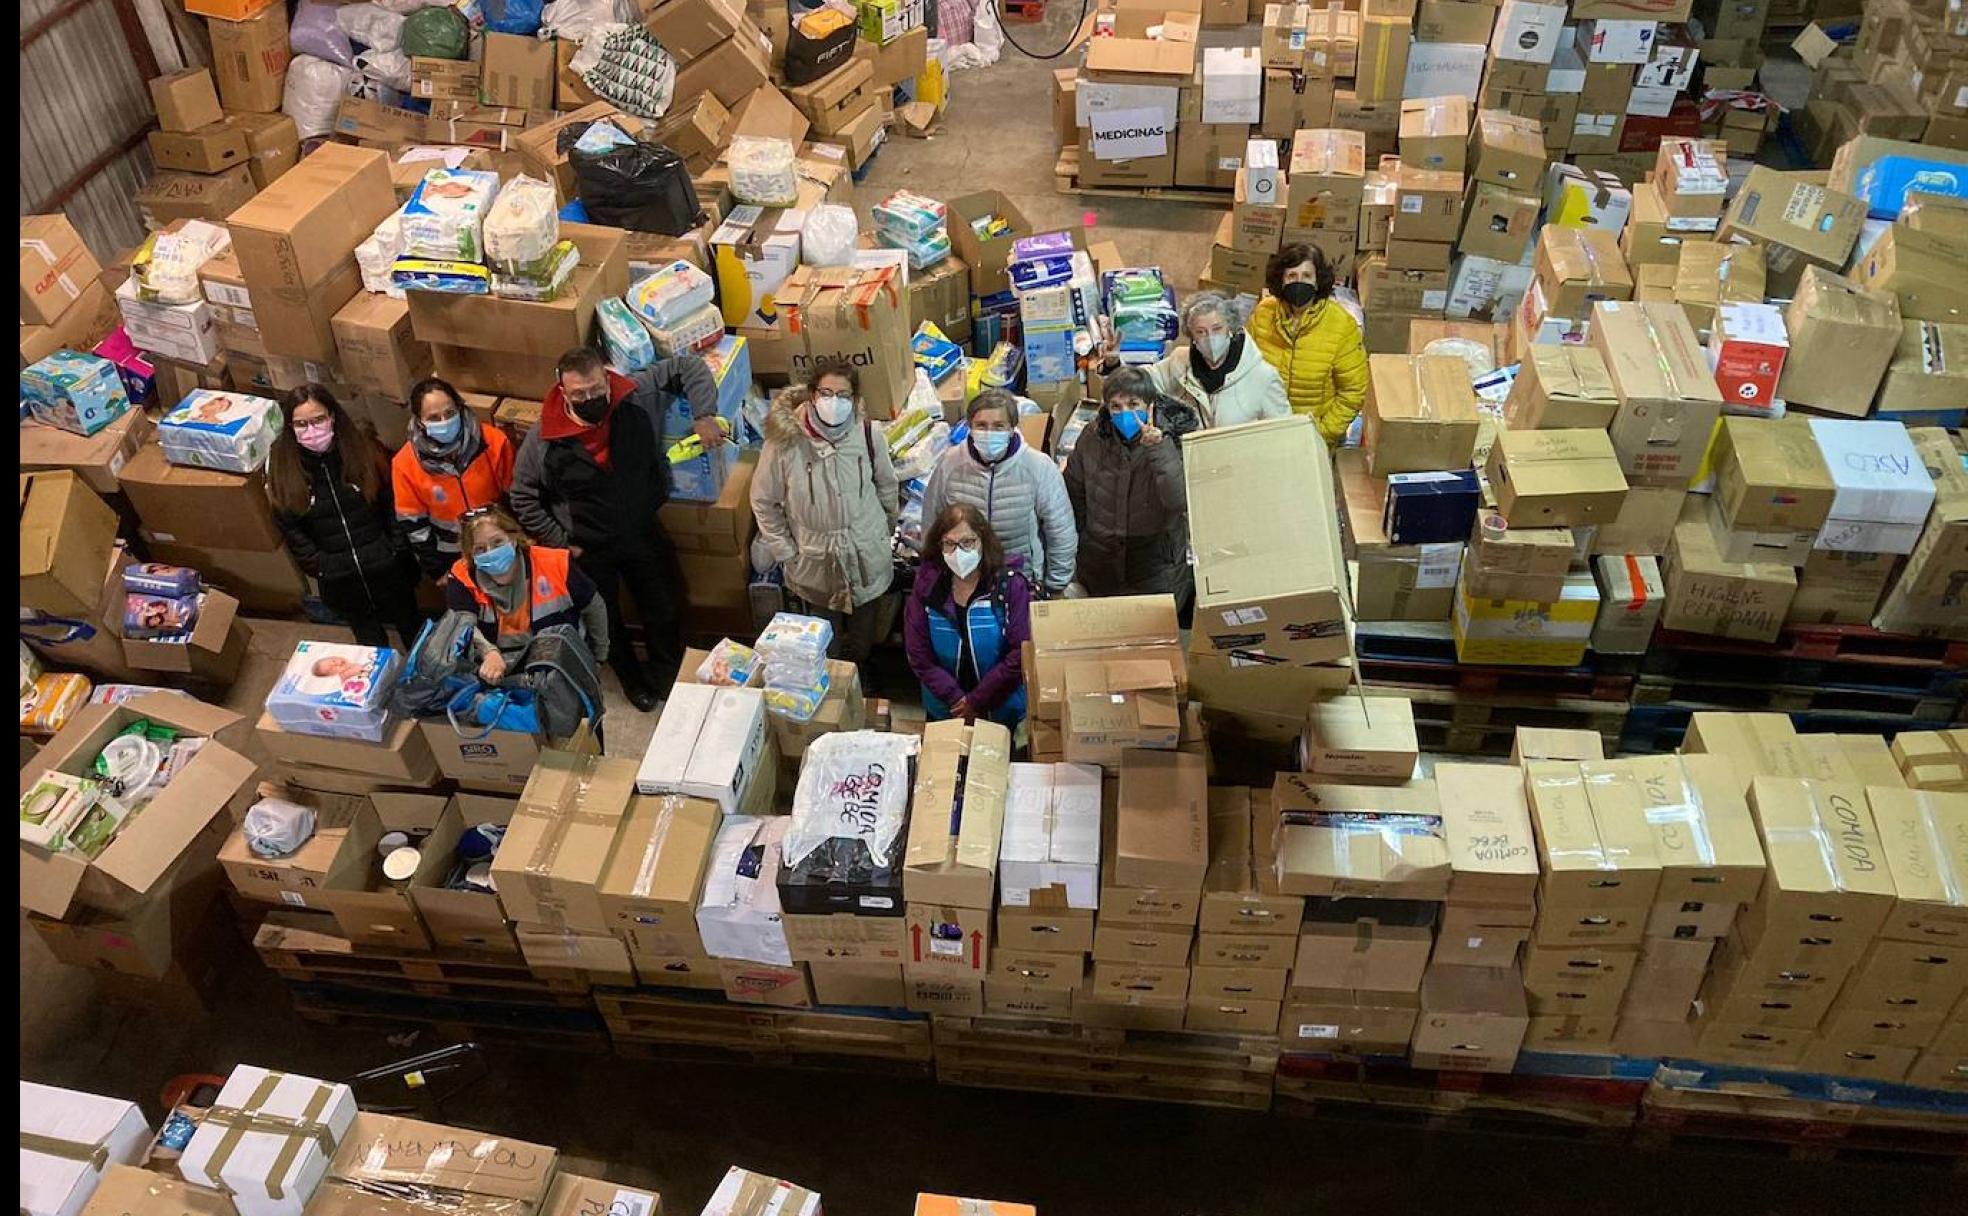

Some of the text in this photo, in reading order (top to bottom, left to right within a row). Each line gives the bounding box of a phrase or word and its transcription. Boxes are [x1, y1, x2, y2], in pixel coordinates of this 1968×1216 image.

[1095, 126, 1164, 141] MEDICINAS
[1844, 452, 1909, 476] ASEO
[859, 763, 886, 835] COMIDA
[1829, 794, 1876, 872] COMIDA
[1474, 845, 1529, 862] COMIDA
